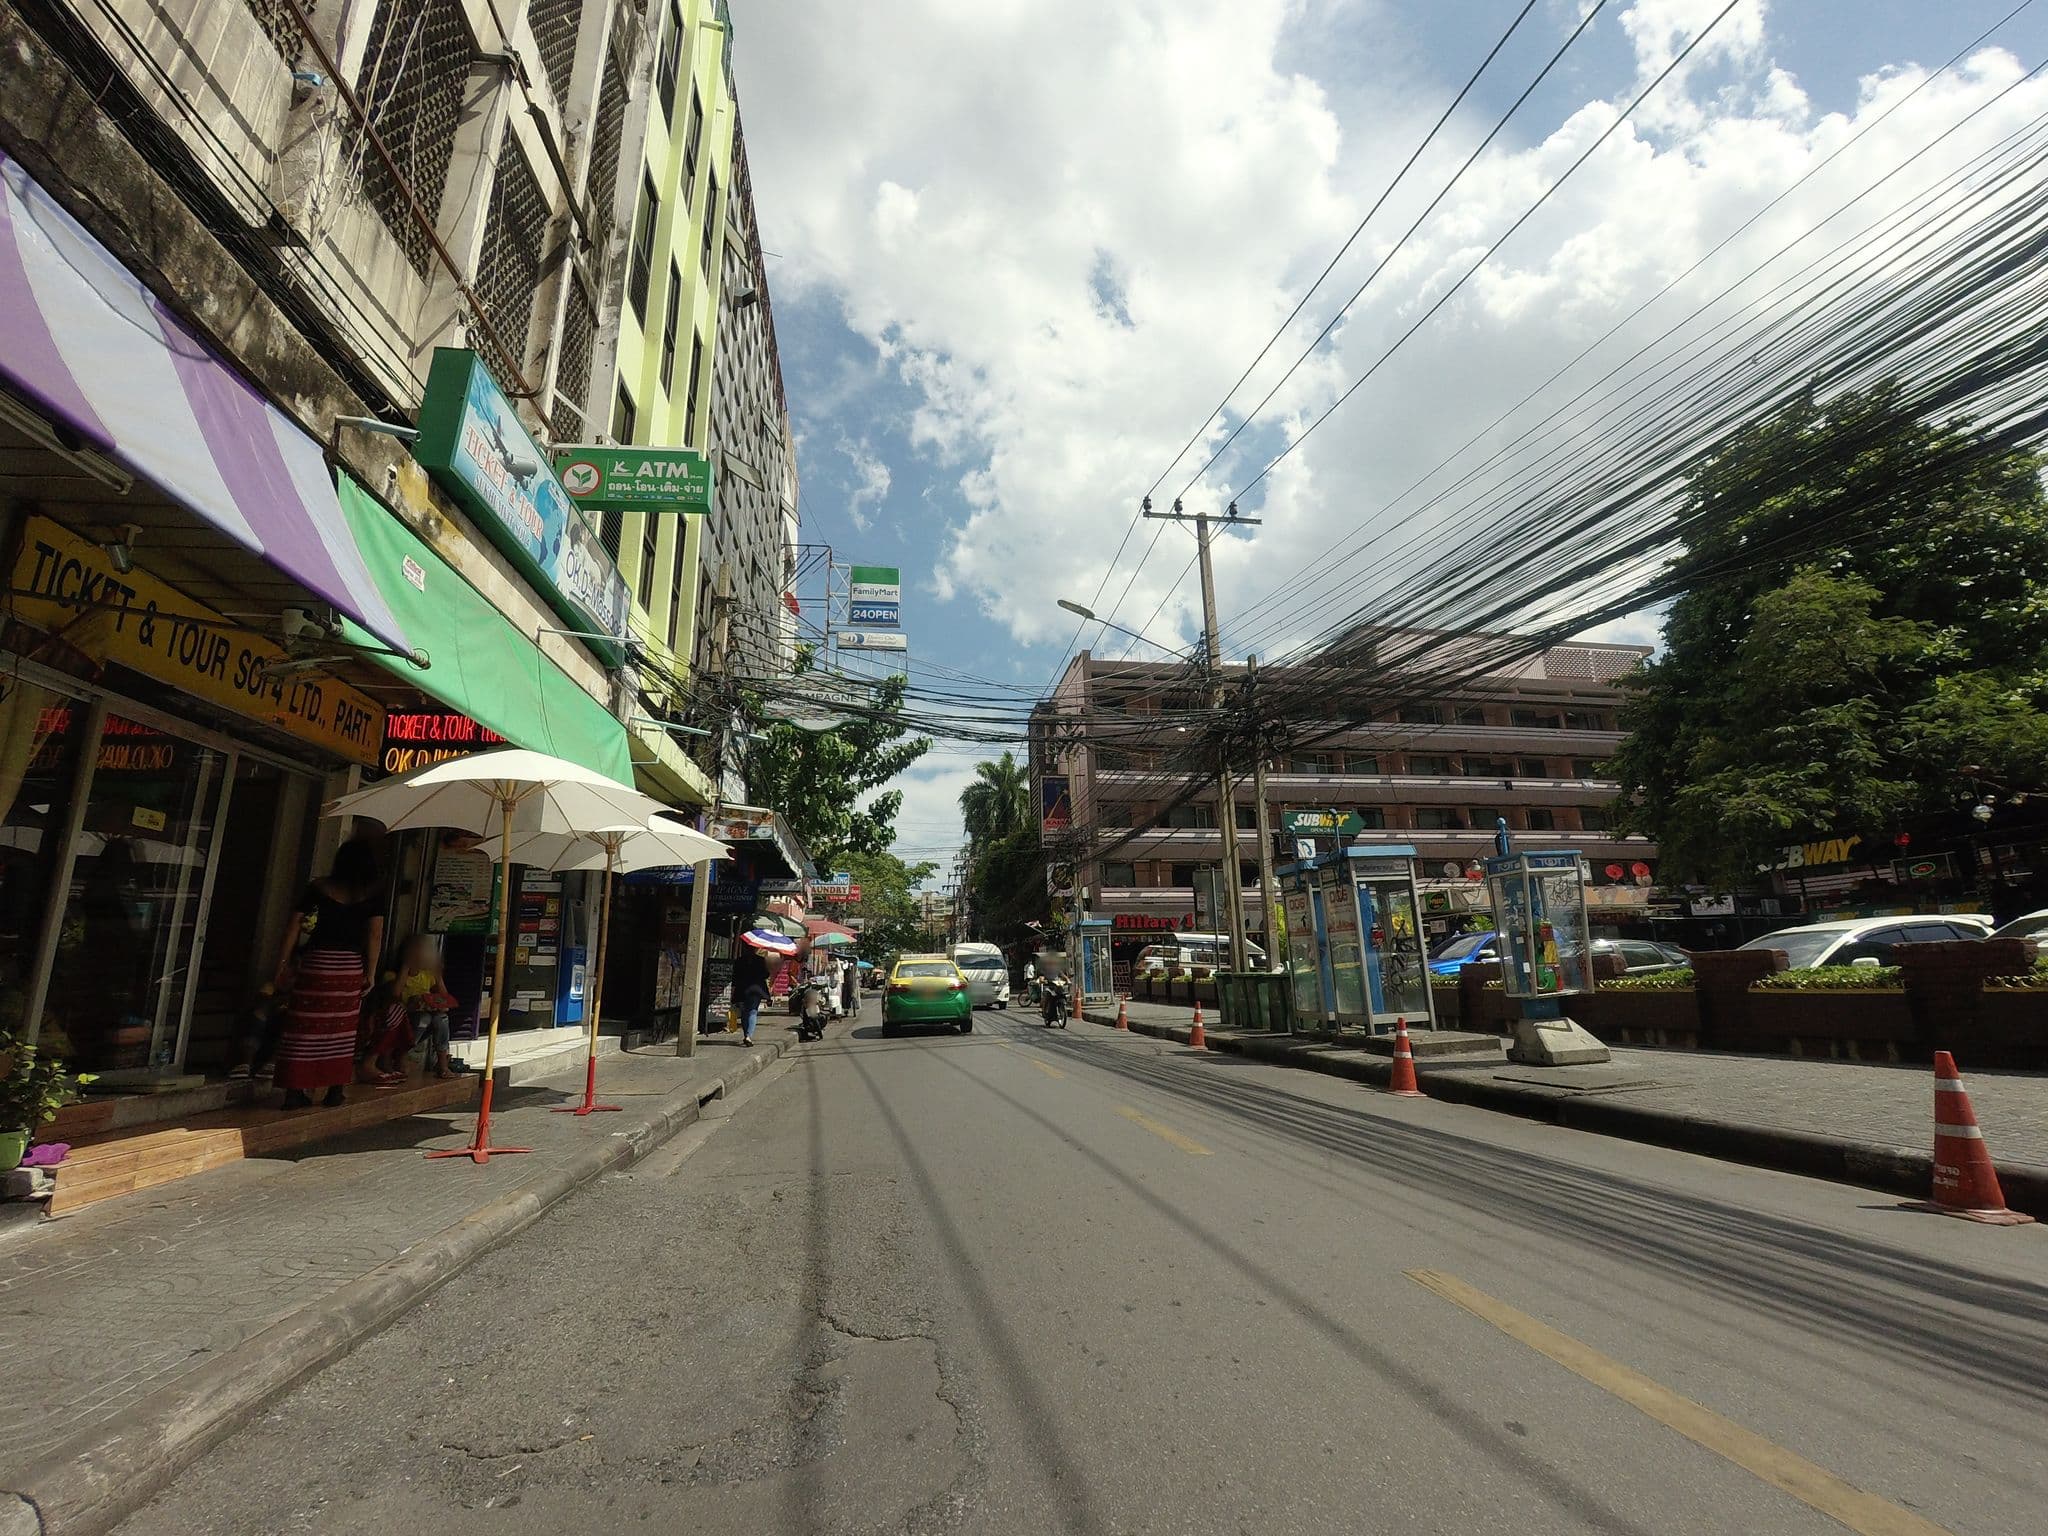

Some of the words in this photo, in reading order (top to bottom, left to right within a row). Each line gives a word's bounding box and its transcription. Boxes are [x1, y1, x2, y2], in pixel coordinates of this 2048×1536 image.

[636, 461, 689, 478] ATM
[466, 425, 508, 490] TICKET
[519, 494, 544, 539] TOUR
[853, 587, 898, 597] FamilyMart
[139, 600, 157, 648] &
[167, 614, 230, 681] TOUR
[334, 698, 372, 747] PART.
[388, 714, 431, 740] TICKET
[430, 715, 440, 740] &
[443, 714, 477, 742] TOUR
[1756, 834, 1863, 872] BWAY
[811, 886, 848, 894] AUNDRY
[1115, 914, 1179, 930] Hillary
